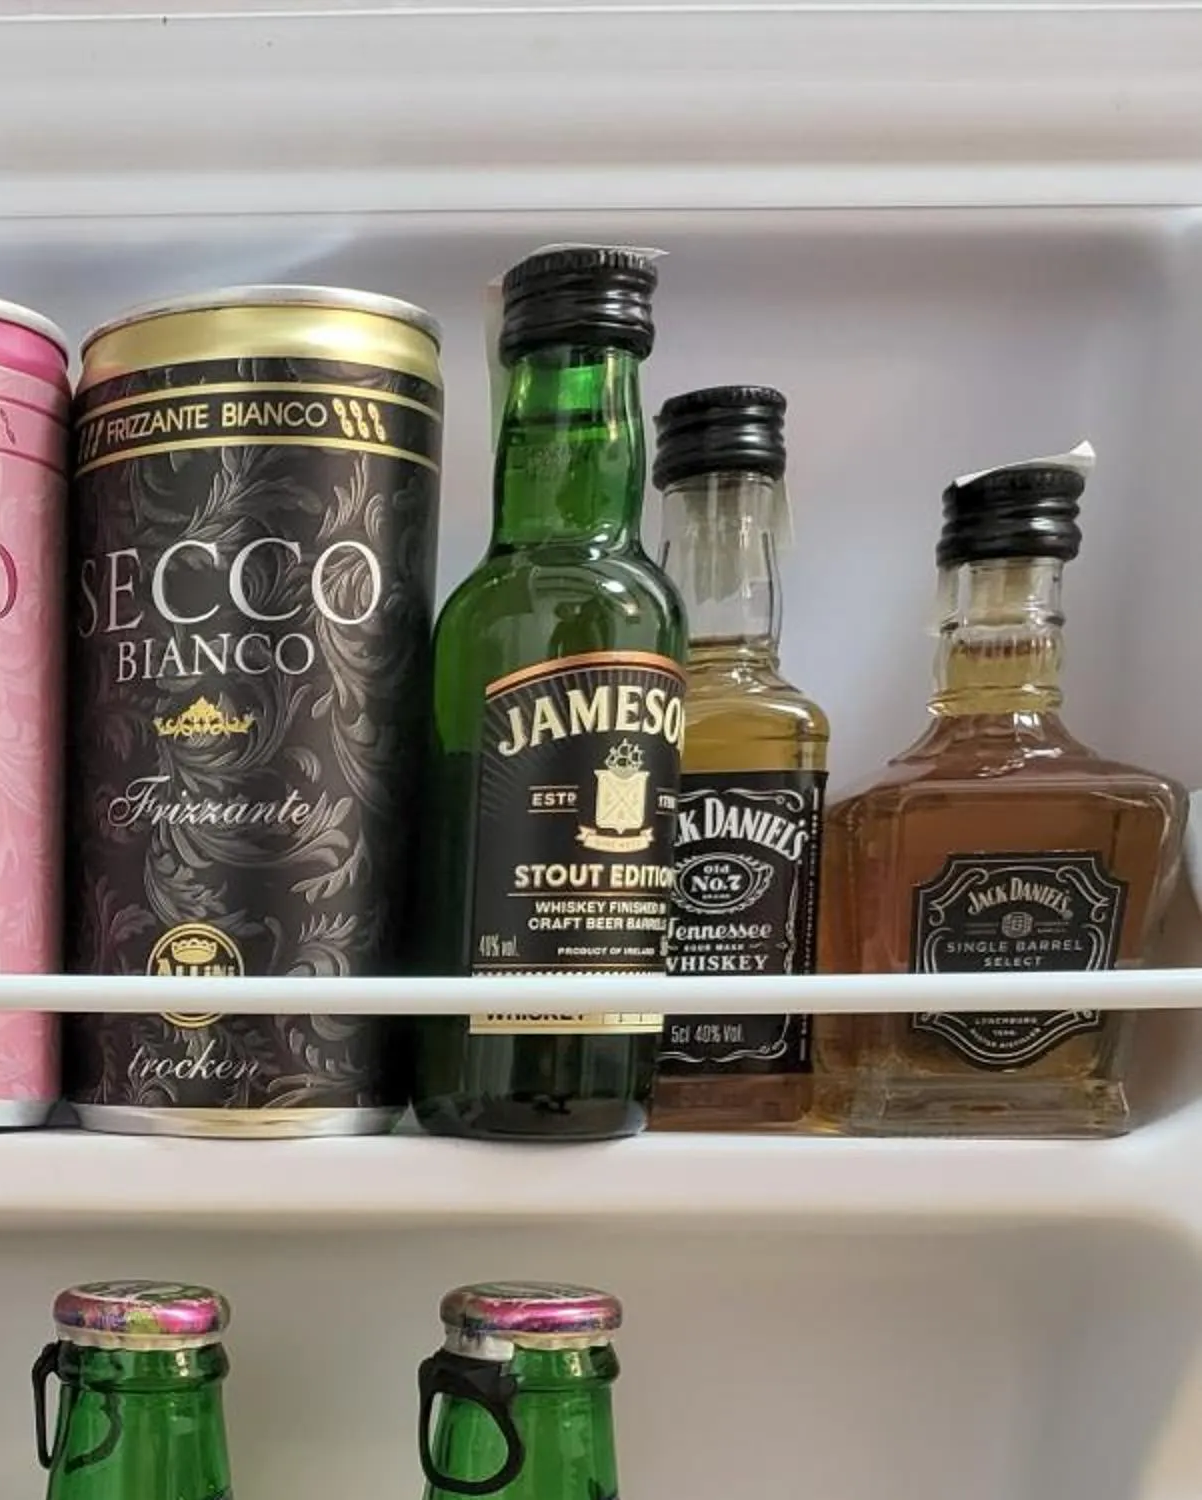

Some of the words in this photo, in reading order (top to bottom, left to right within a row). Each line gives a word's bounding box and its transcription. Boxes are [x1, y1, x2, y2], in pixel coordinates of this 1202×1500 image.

[106, 403, 210, 444] FRIZZANTE
[220, 401, 329, 429] BIANCO
[77, 536, 382, 640] SECCO
[114, 632, 316, 684] BIANCO
[497, 683, 686, 758] JAMESO
[106, 774, 313, 828] Frizzante
[513, 863, 603, 889] STOUT
[609, 863, 677, 888] EDITIO
[535, 901, 605, 914] WHISKEY
[967, 886, 1008, 916] JACK
[527, 917, 581, 931] CRAFT
[585, 917, 624, 931] BEER
[557, 946, 607, 956] PRODUCT
[946, 941, 1008, 954] SINGLE
[1015, 939, 1084, 952] BARREL
[983, 956, 1044, 968] SELECT
[695, 1023, 722, 1043] 40%
[127, 1037, 260, 1081] trocken
